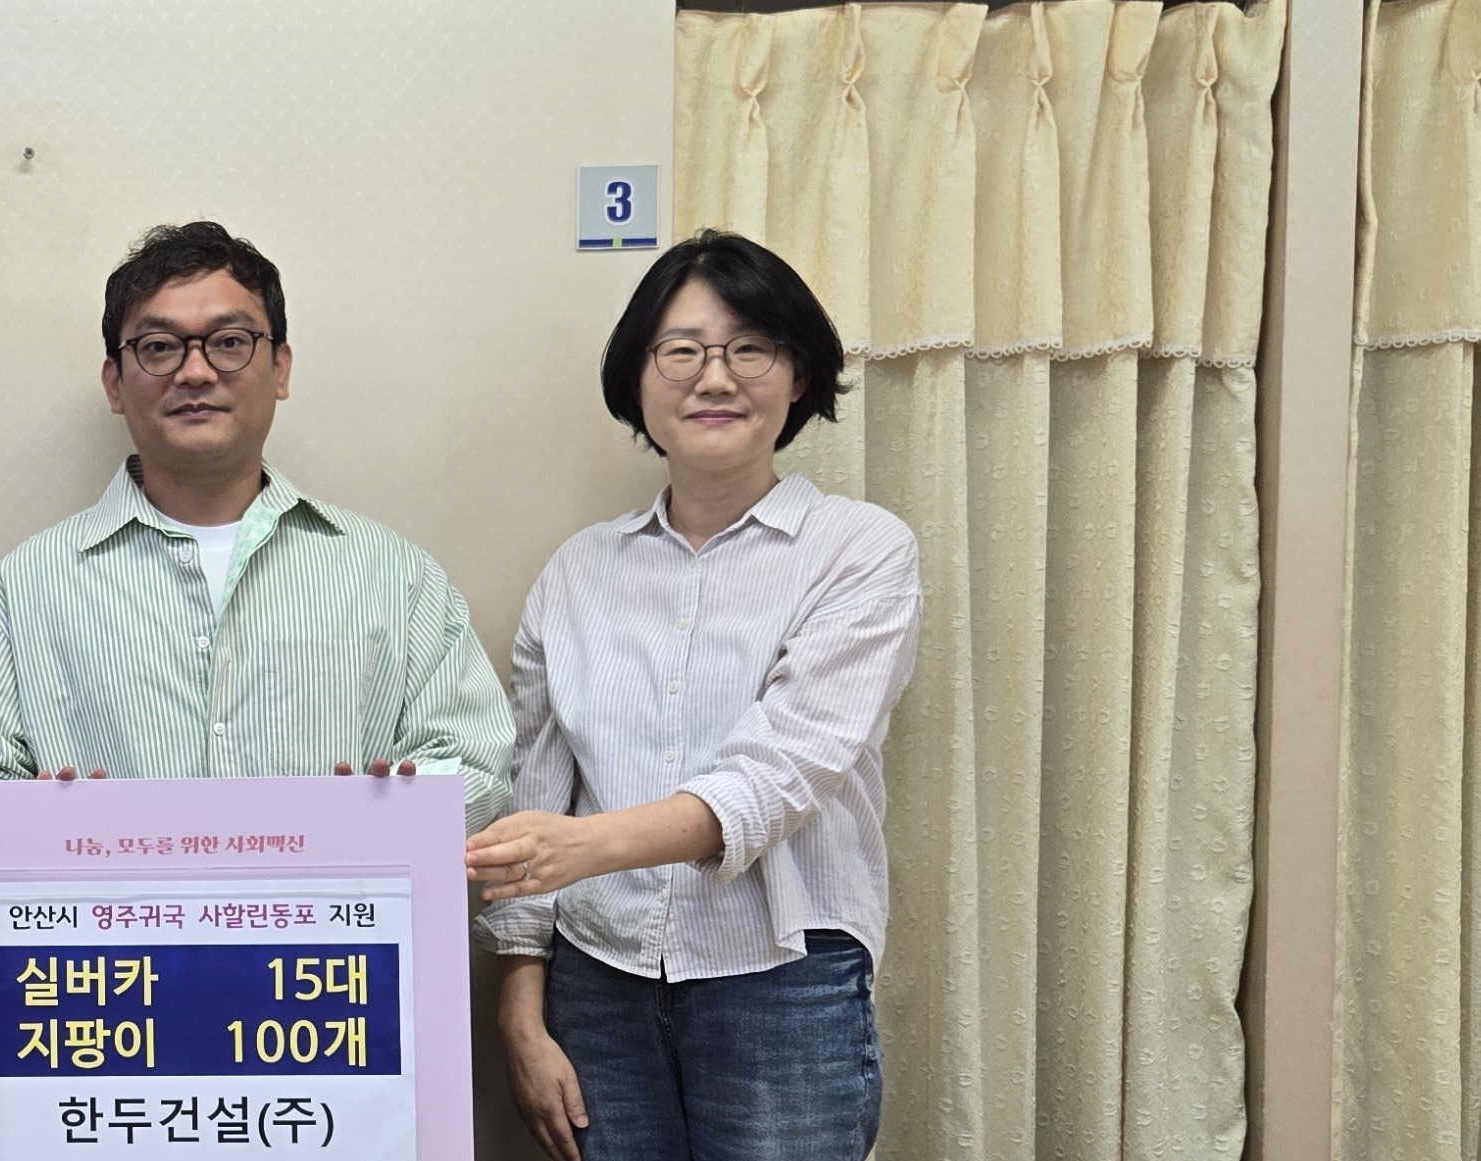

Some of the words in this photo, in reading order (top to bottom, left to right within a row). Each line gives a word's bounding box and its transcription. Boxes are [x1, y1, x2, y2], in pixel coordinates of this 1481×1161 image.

[606, 180, 632, 223] 3
[65, 838, 111, 857] 나눔,
[118, 837, 174, 855] 모두를
[180, 835, 220, 854] 위한
[9, 905, 78, 930] 안산시
[92, 905, 186, 929] 영주귀국
[199, 903, 316, 928] 사할린동포
[329, 903, 376, 928] 지원
[17, 955, 159, 1007] 실버카
[268, 954, 368, 1005] 15대
[17, 1018, 155, 1069] 지팡이
[227, 1016, 367, 1067] 100개
[58, 1095, 334, 1148] 한두건설(주)
